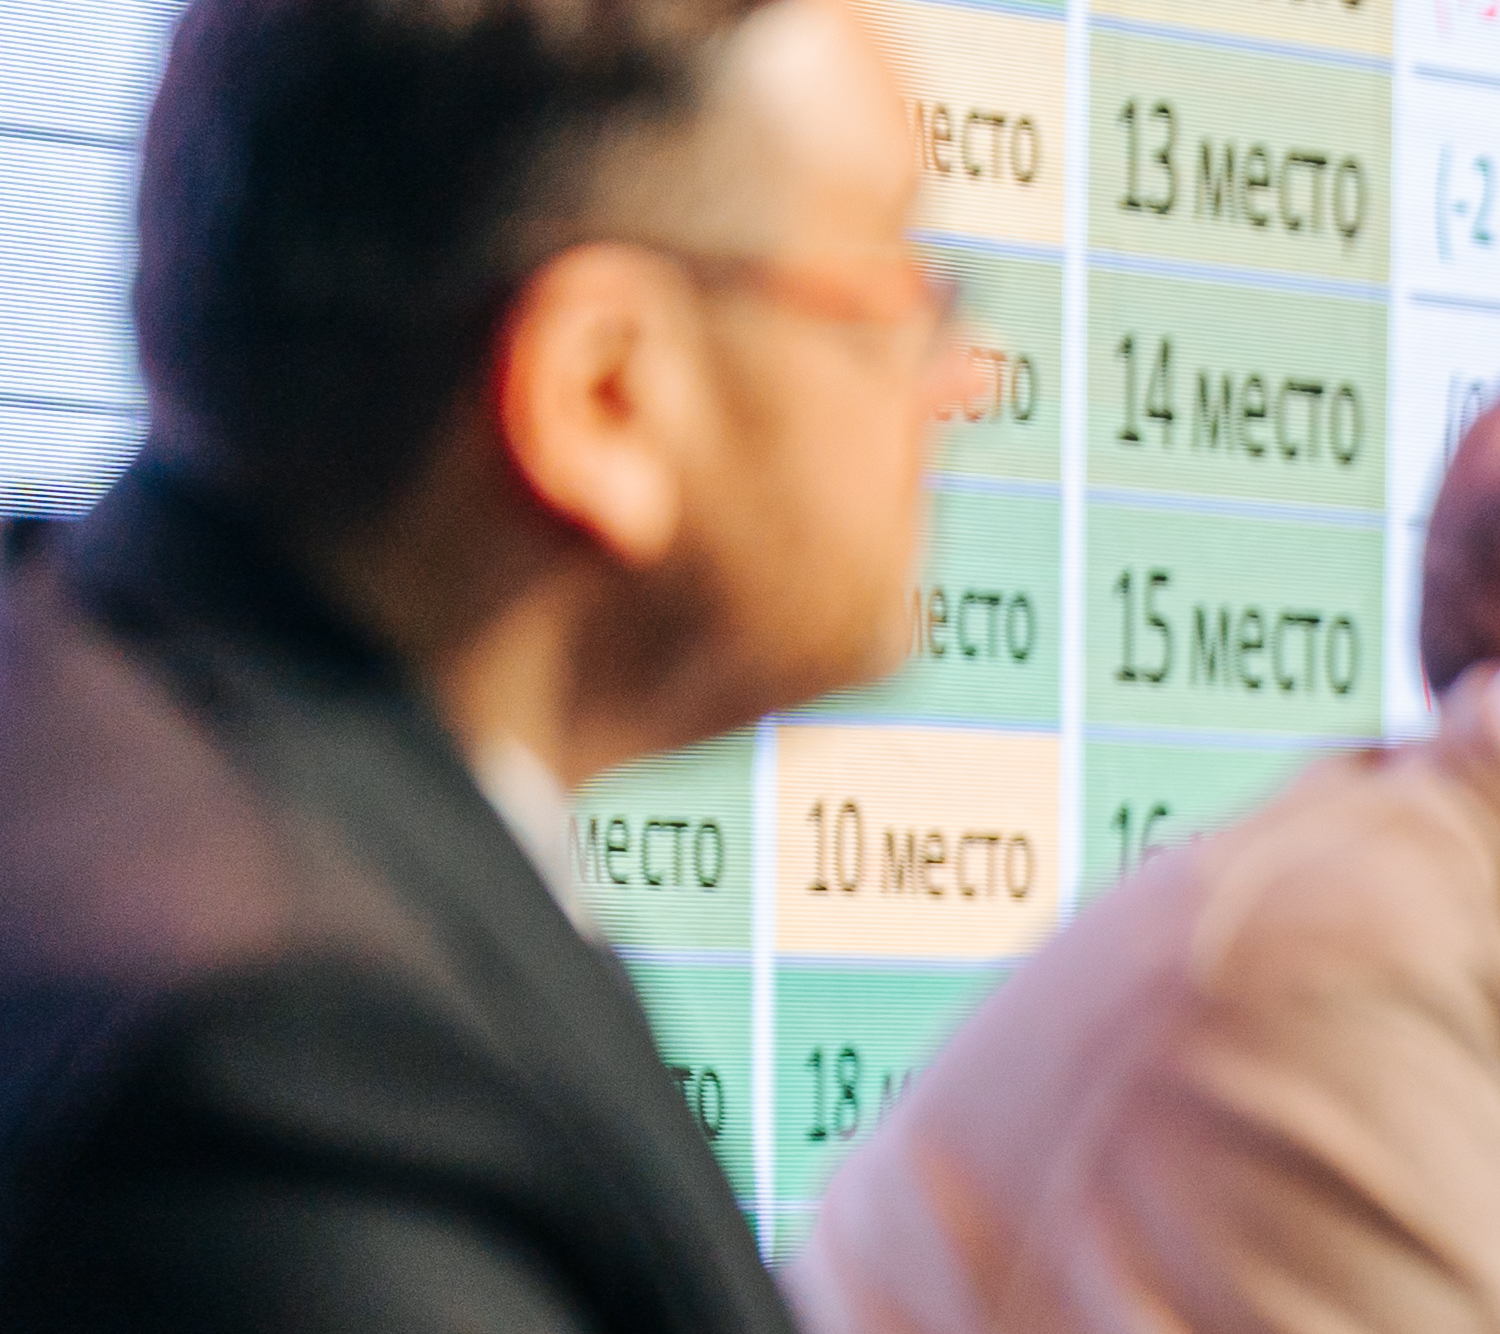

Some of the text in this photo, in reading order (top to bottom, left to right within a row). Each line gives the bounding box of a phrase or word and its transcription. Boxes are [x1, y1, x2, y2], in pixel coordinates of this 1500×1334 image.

[1119, 100, 1363, 237] 13 место
[1117, 334, 1178, 447] 14
[1195, 372, 1361, 468] место
[1115, 567, 1356, 698] 15 место
[807, 798, 1033, 903] 10 место
[806, 1044, 861, 1145] 18
